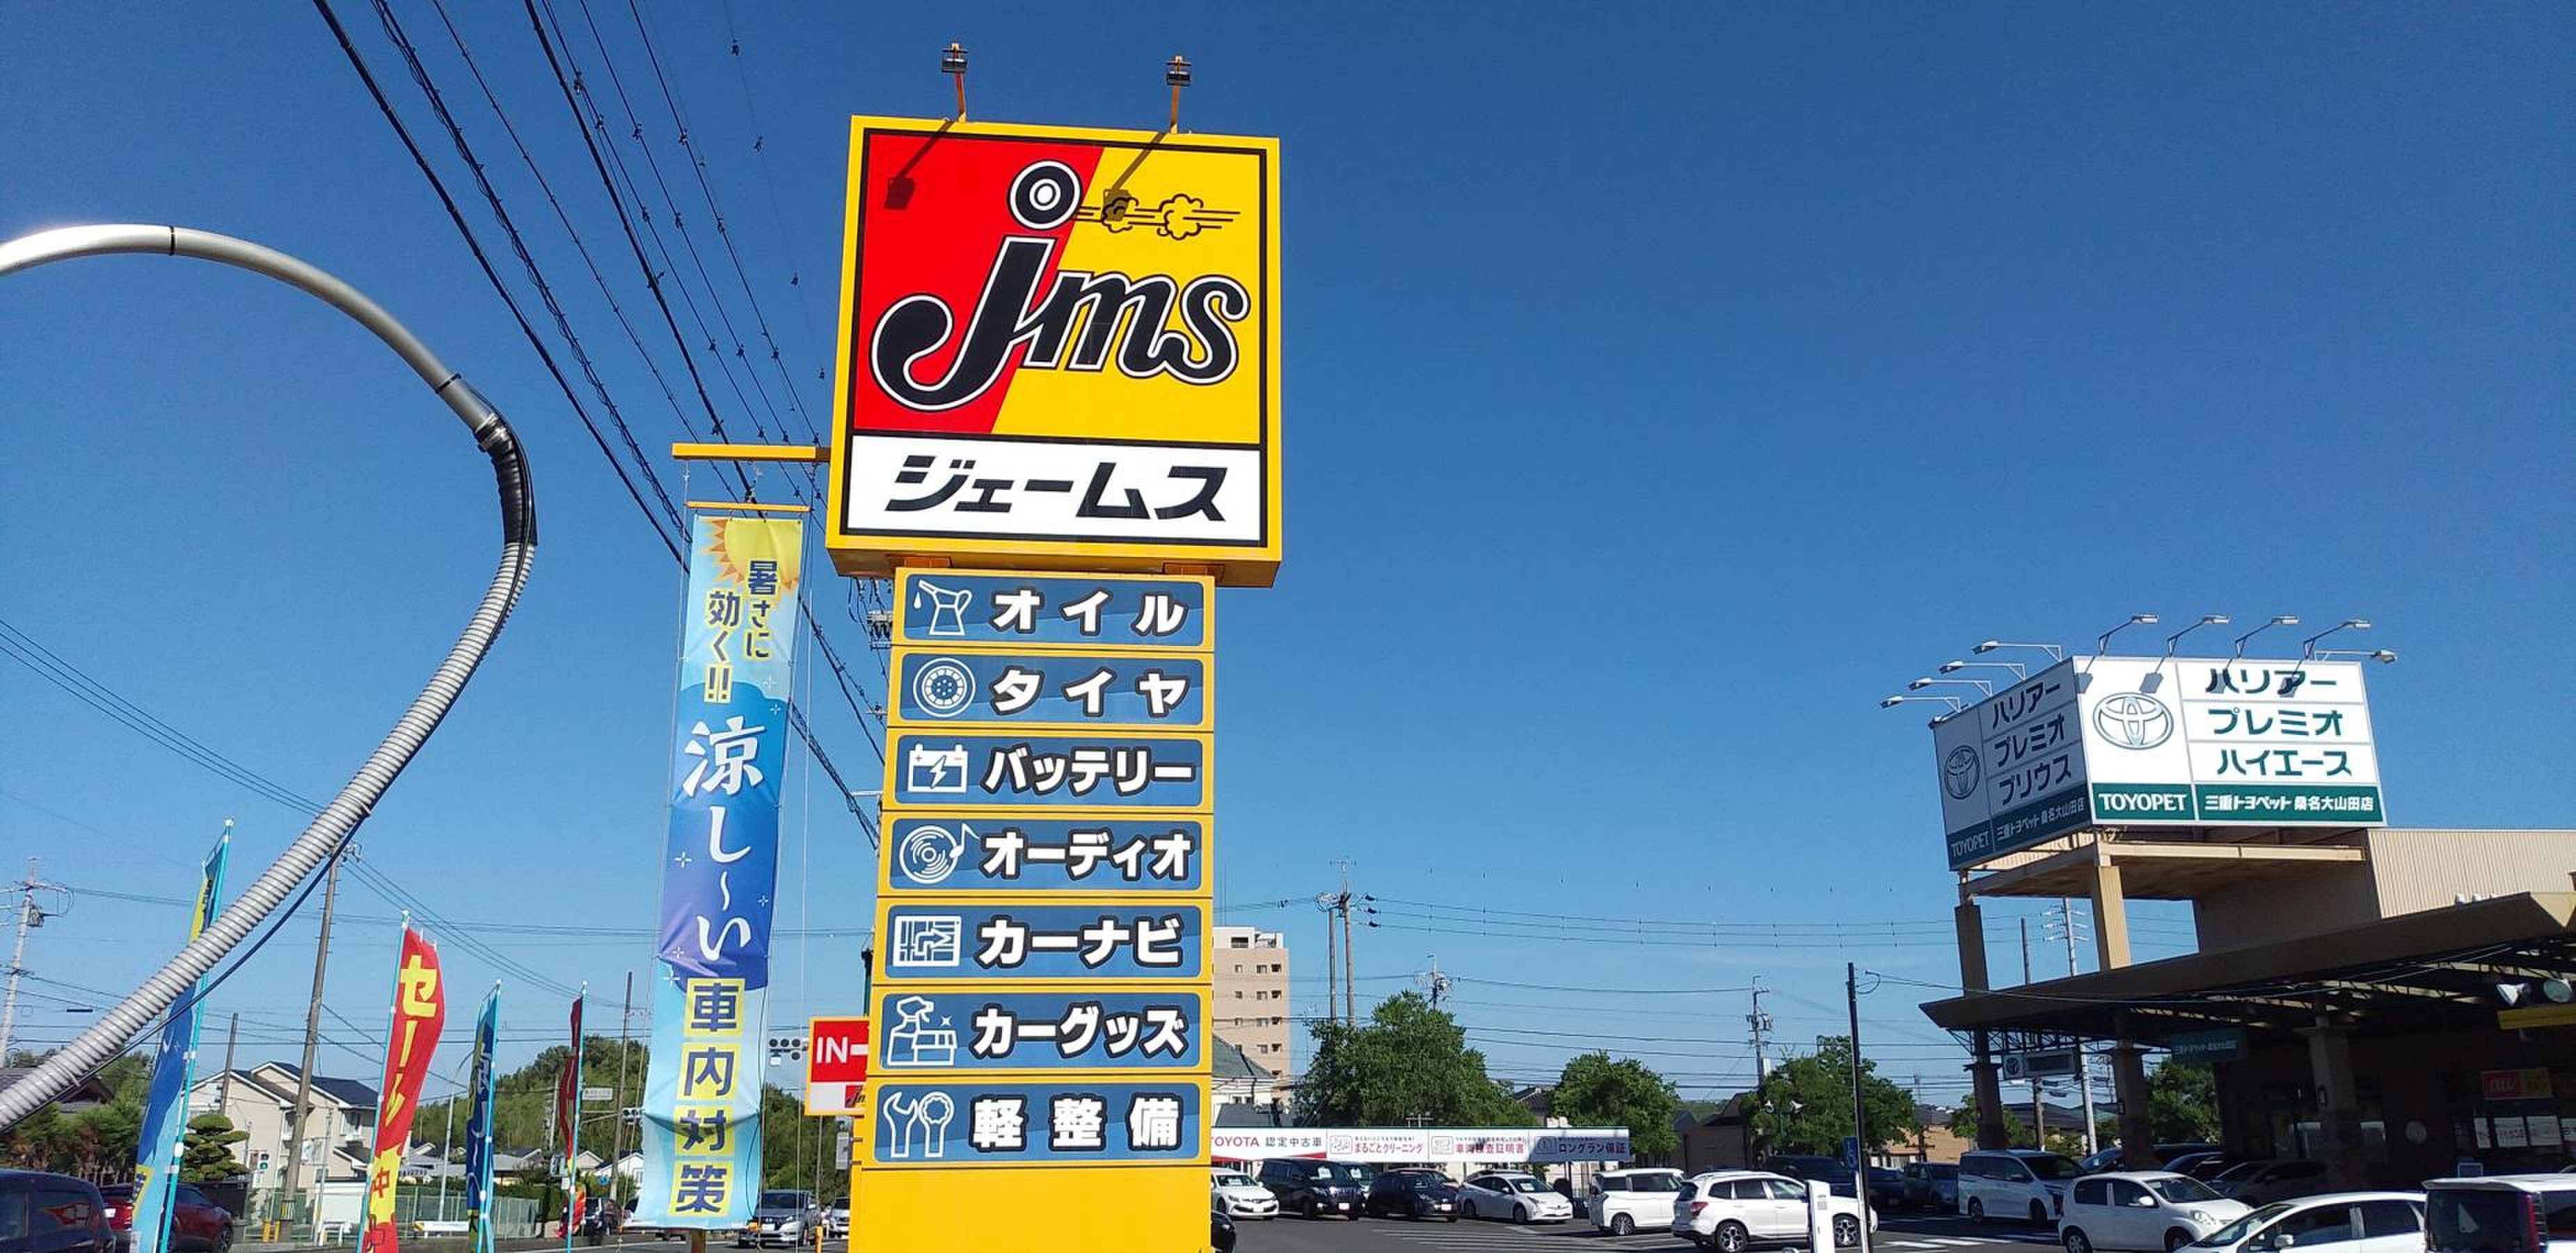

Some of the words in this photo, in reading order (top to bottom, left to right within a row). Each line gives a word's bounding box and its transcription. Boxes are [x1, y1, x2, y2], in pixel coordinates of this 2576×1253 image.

[868, 159, 1251, 411] jms
[884, 454, 1227, 522] ジェームス
[746, 560, 778, 658] 暑さに
[991, 589, 1186, 636] オイル
[992, 669, 1188, 716] タイヤ
[1992, 681, 2060, 729] ハリアー
[2206, 667, 2338, 696] ハリアー
[1994, 712, 2065, 767] プレミオ
[2209, 706, 2344, 737] プレミオ
[983, 746, 1193, 798] バッテリー
[1998, 753, 2072, 805] プリウス
[2217, 748, 2353, 777] ハイエース
[2098, 793, 2188, 812] TOYOPET
[2204, 794, 2291, 811] 三重トヨペット
[2294, 796, 2374, 812] 桑名大山田店
[982, 831, 1193, 879] オーディオ
[1950, 830, 1989, 858] TOYOPET
[978, 917, 1185, 968] カーナビ
[973, 1004, 1187, 1057] カーグッズ
[675, 982, 740, 1213] 車内対策
[973, 1096, 1182, 1149] 軽整備
[1265, 1136, 1322, 1147] 認定中古車
[1354, 1142, 1424, 1154] まるごとクリーニング
[1559, 1142, 1626, 1154] ロングラン保証
